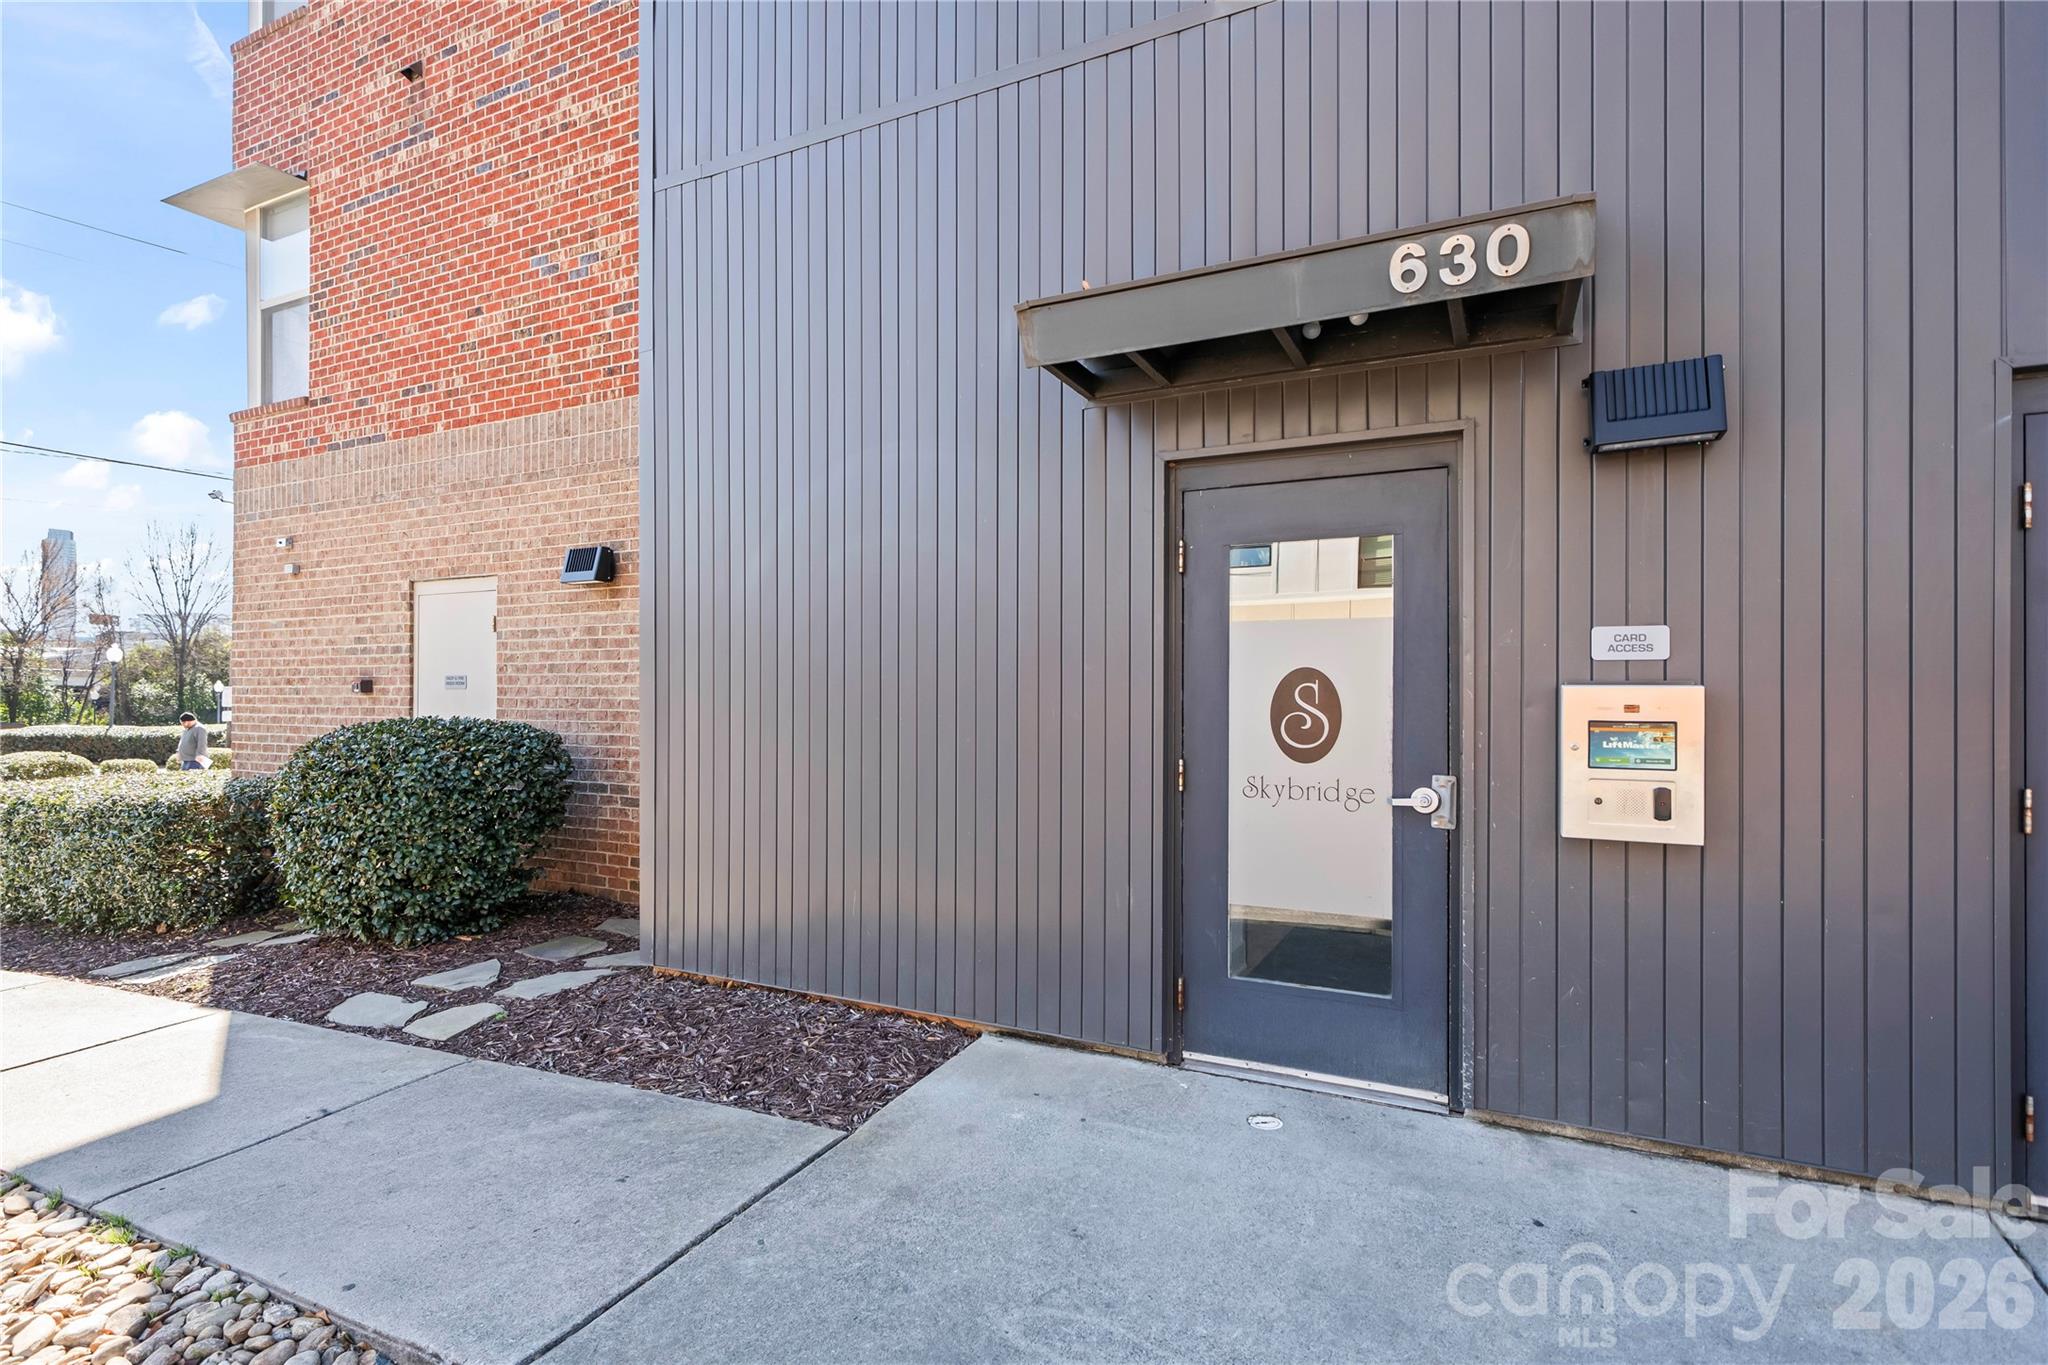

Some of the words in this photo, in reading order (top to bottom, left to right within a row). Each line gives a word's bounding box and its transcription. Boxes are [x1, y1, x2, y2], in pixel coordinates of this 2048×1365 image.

[1389, 223, 1530, 294] 630
[1607, 643, 1654, 653] ACCESS
[1613, 633, 1647, 642] CARD
[1242, 775, 1376, 813] Skybridge
